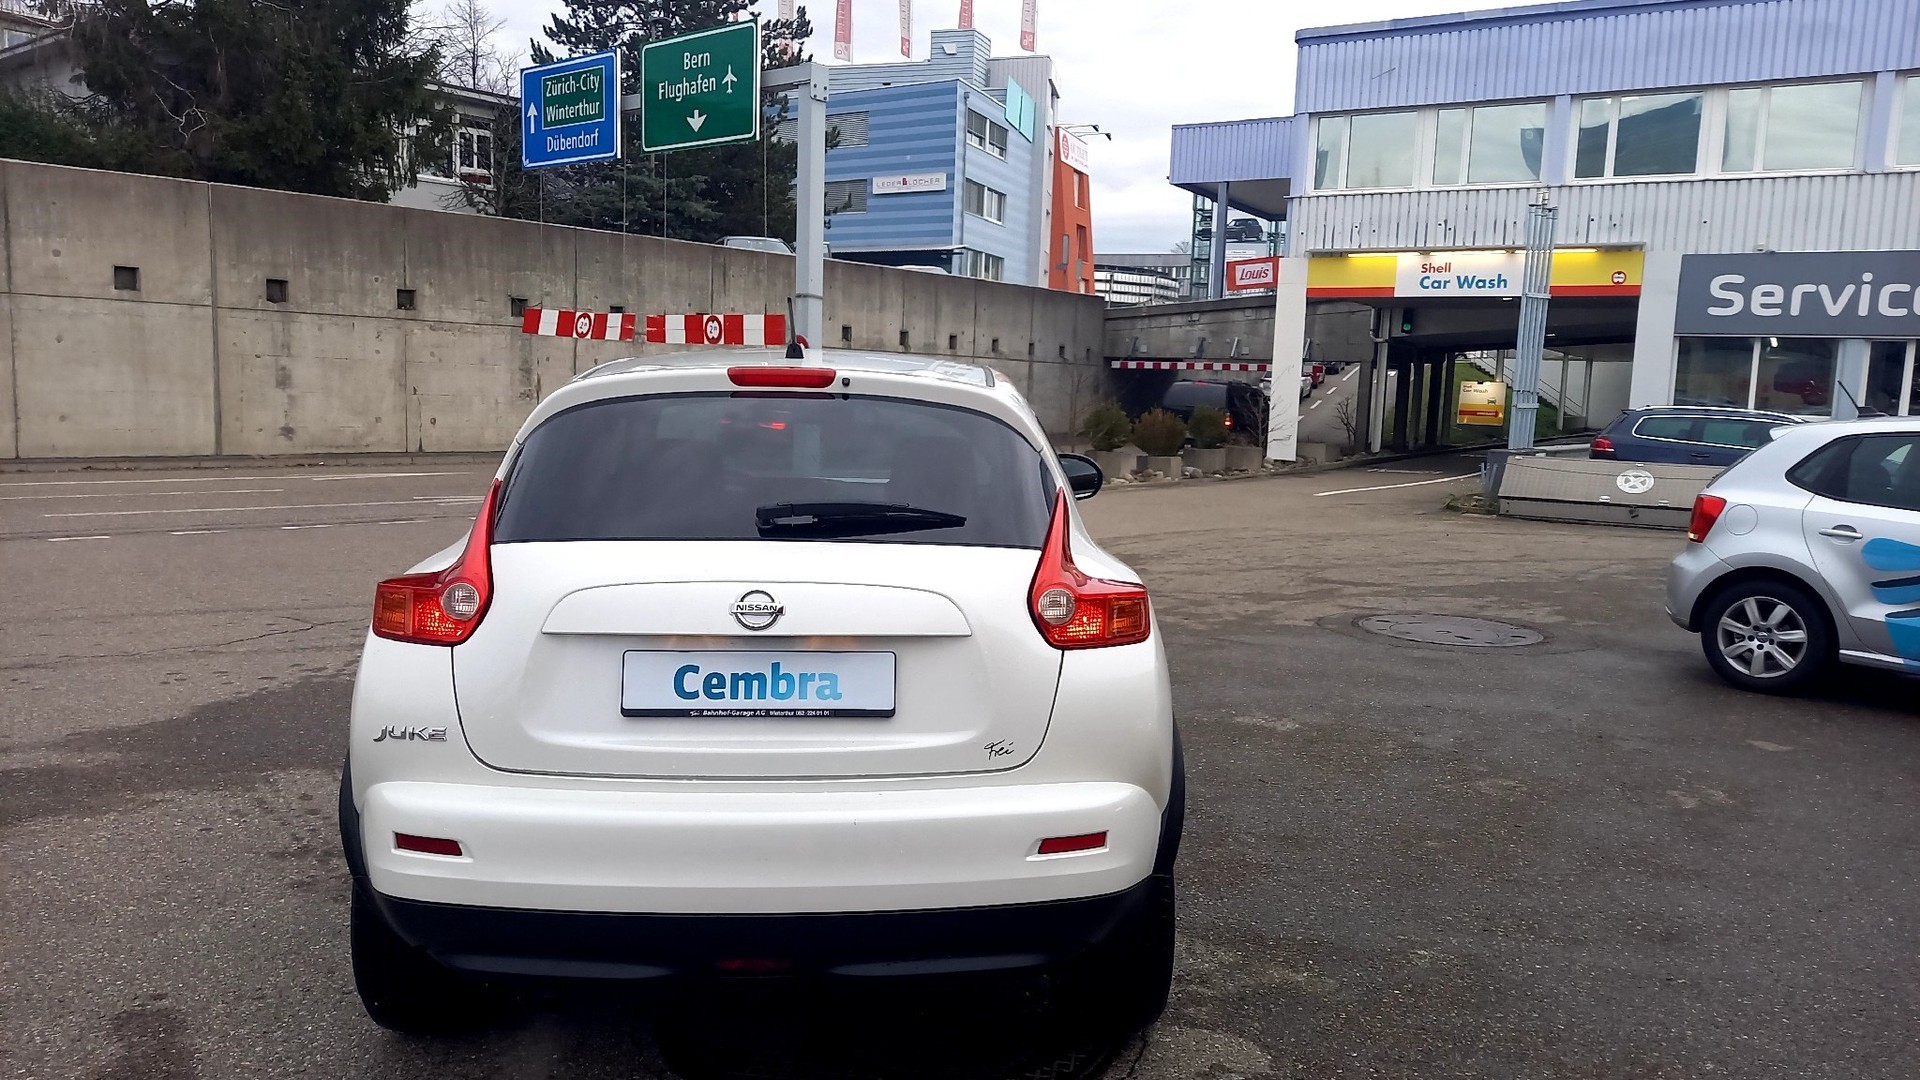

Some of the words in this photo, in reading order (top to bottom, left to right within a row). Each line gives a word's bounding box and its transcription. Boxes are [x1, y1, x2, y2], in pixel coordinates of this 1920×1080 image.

[683, 52, 710, 70] Bern
[546, 73, 600, 97] Zürich-City
[658, 73, 716, 102] Flughafen
[546, 98, 600, 122] Winterthur
[546, 128, 599, 153] Dübendorf
[1239, 266, 1270, 281] Louis
[1420, 262, 1452, 274] Shell
[1420, 275, 1451, 290] Car
[1456, 273, 1508, 290] Wash
[1707, 272, 1920, 317] Servic
[735, 603, 778, 612] NISSAN
[673, 661, 843, 701] Cembra
[702, 709, 755, 717] Bahnhof-Garage
[372, 724, 448, 743] JUKE
